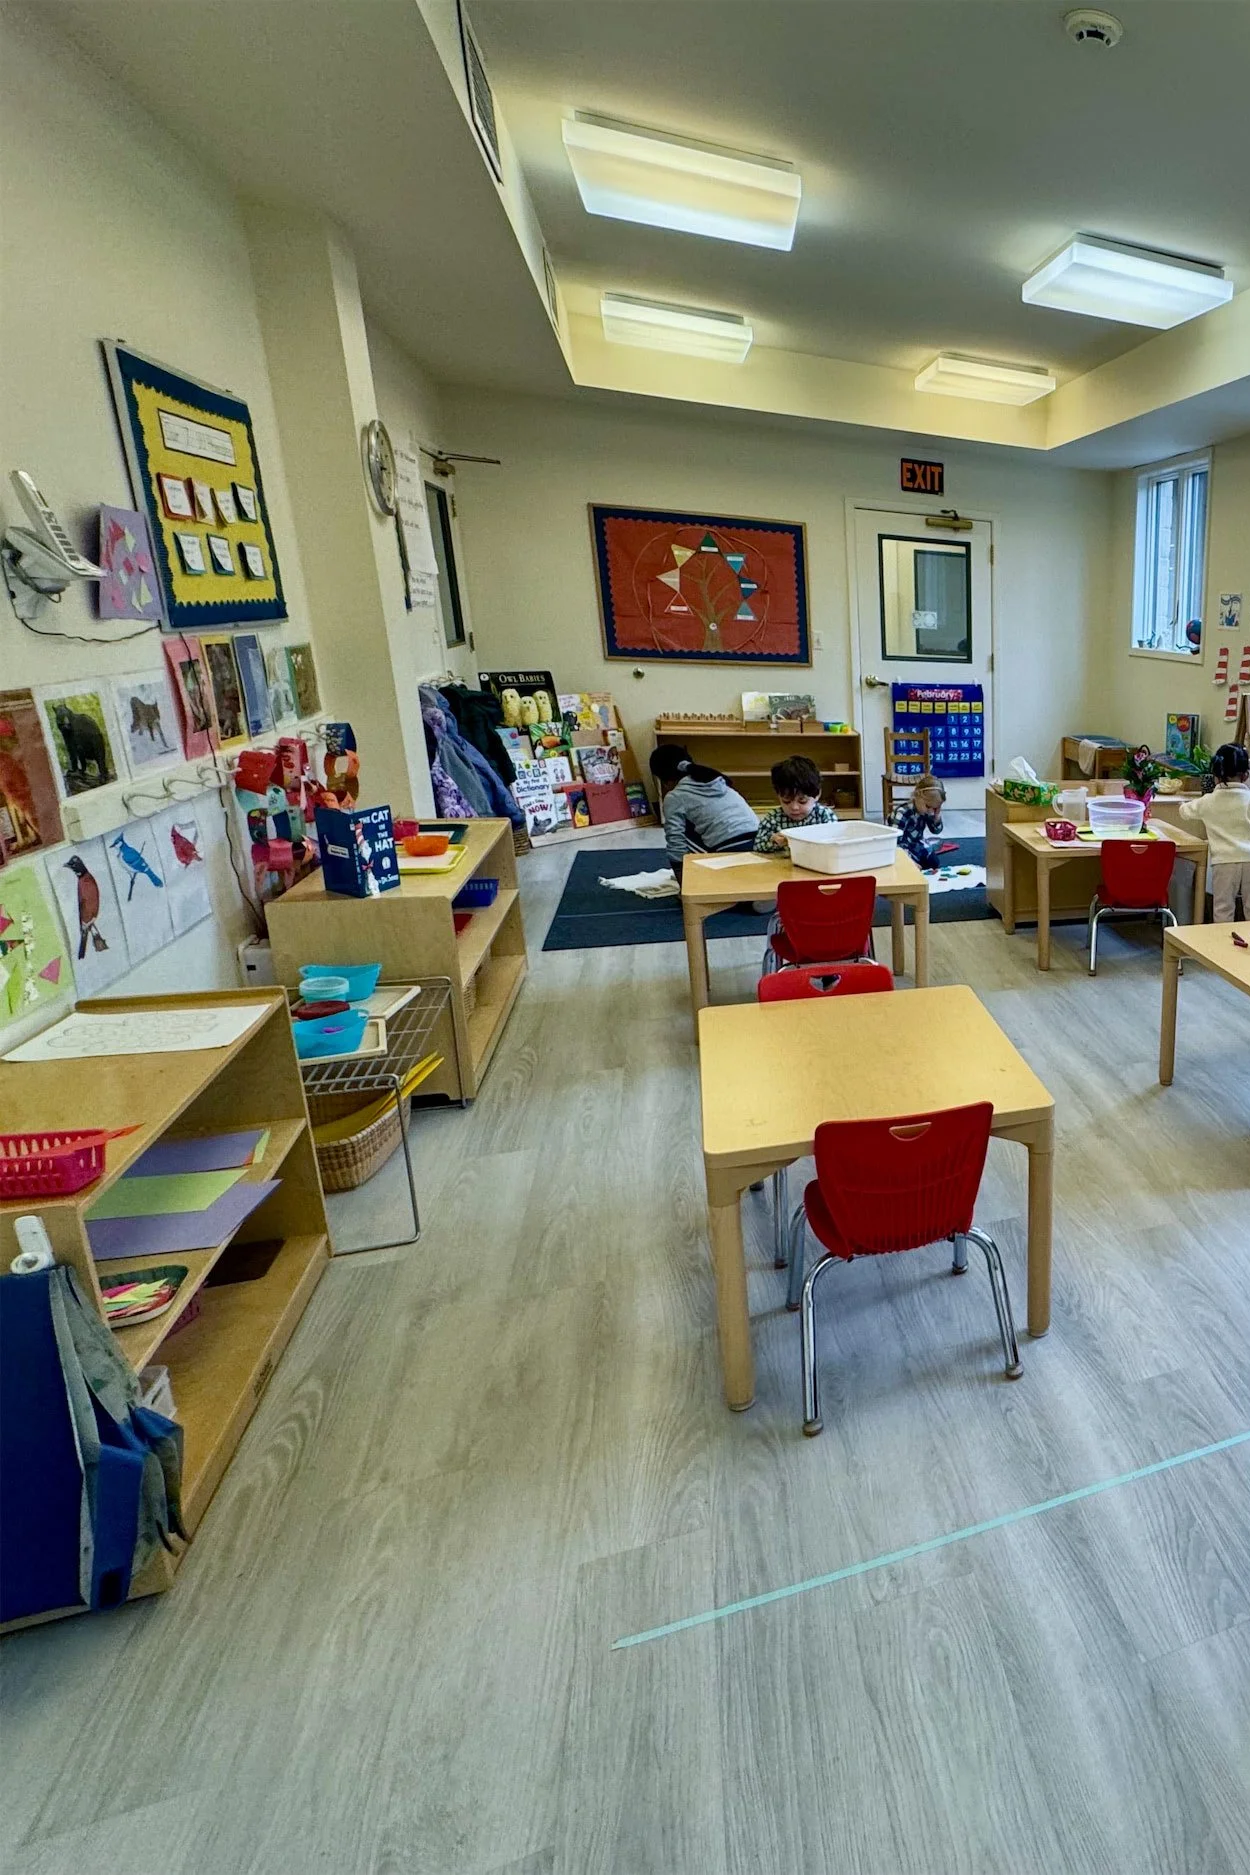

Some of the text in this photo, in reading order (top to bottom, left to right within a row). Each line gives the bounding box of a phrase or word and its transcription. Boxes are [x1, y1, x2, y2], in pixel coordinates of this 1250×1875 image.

[902, 462, 943, 491] EXIT
[499, 674, 546, 684] OWL BABIES
[916, 689, 955, 700] February
[910, 765, 921, 773] 26
[516, 783, 550, 794] Dictionary
[528, 804, 553, 815] NOW!
[358, 810, 389, 824] THE CAT
[378, 823, 386, 831] IN
[377, 831, 389, 839] THE
[374, 837, 394, 852] HAT
